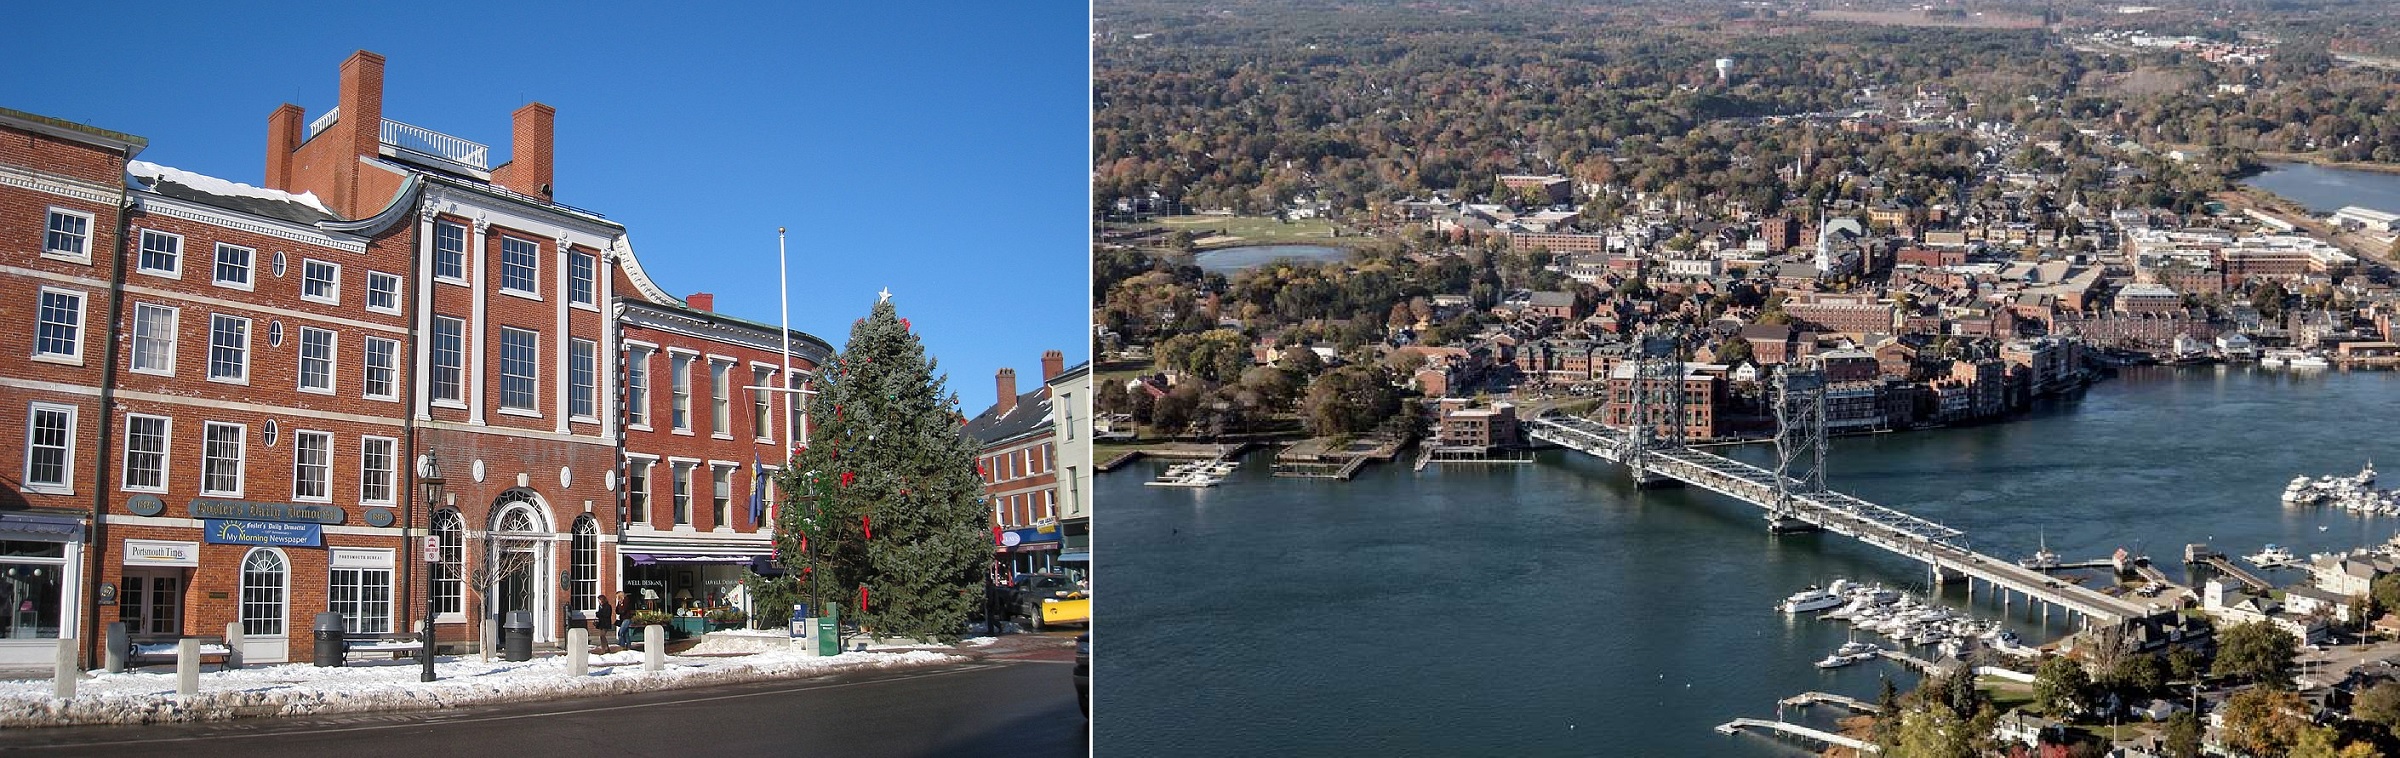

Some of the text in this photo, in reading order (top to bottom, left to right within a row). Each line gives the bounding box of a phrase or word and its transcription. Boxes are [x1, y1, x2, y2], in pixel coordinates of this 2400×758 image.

[197, 502, 336, 520] Foster's Daily Democrat
[246, 522, 266, 530] Foster's
[284, 523, 306, 531] Democrat
[226, 533, 308, 544] My Morning Newspaper
[132, 546, 183, 557] Portsmouth Times
